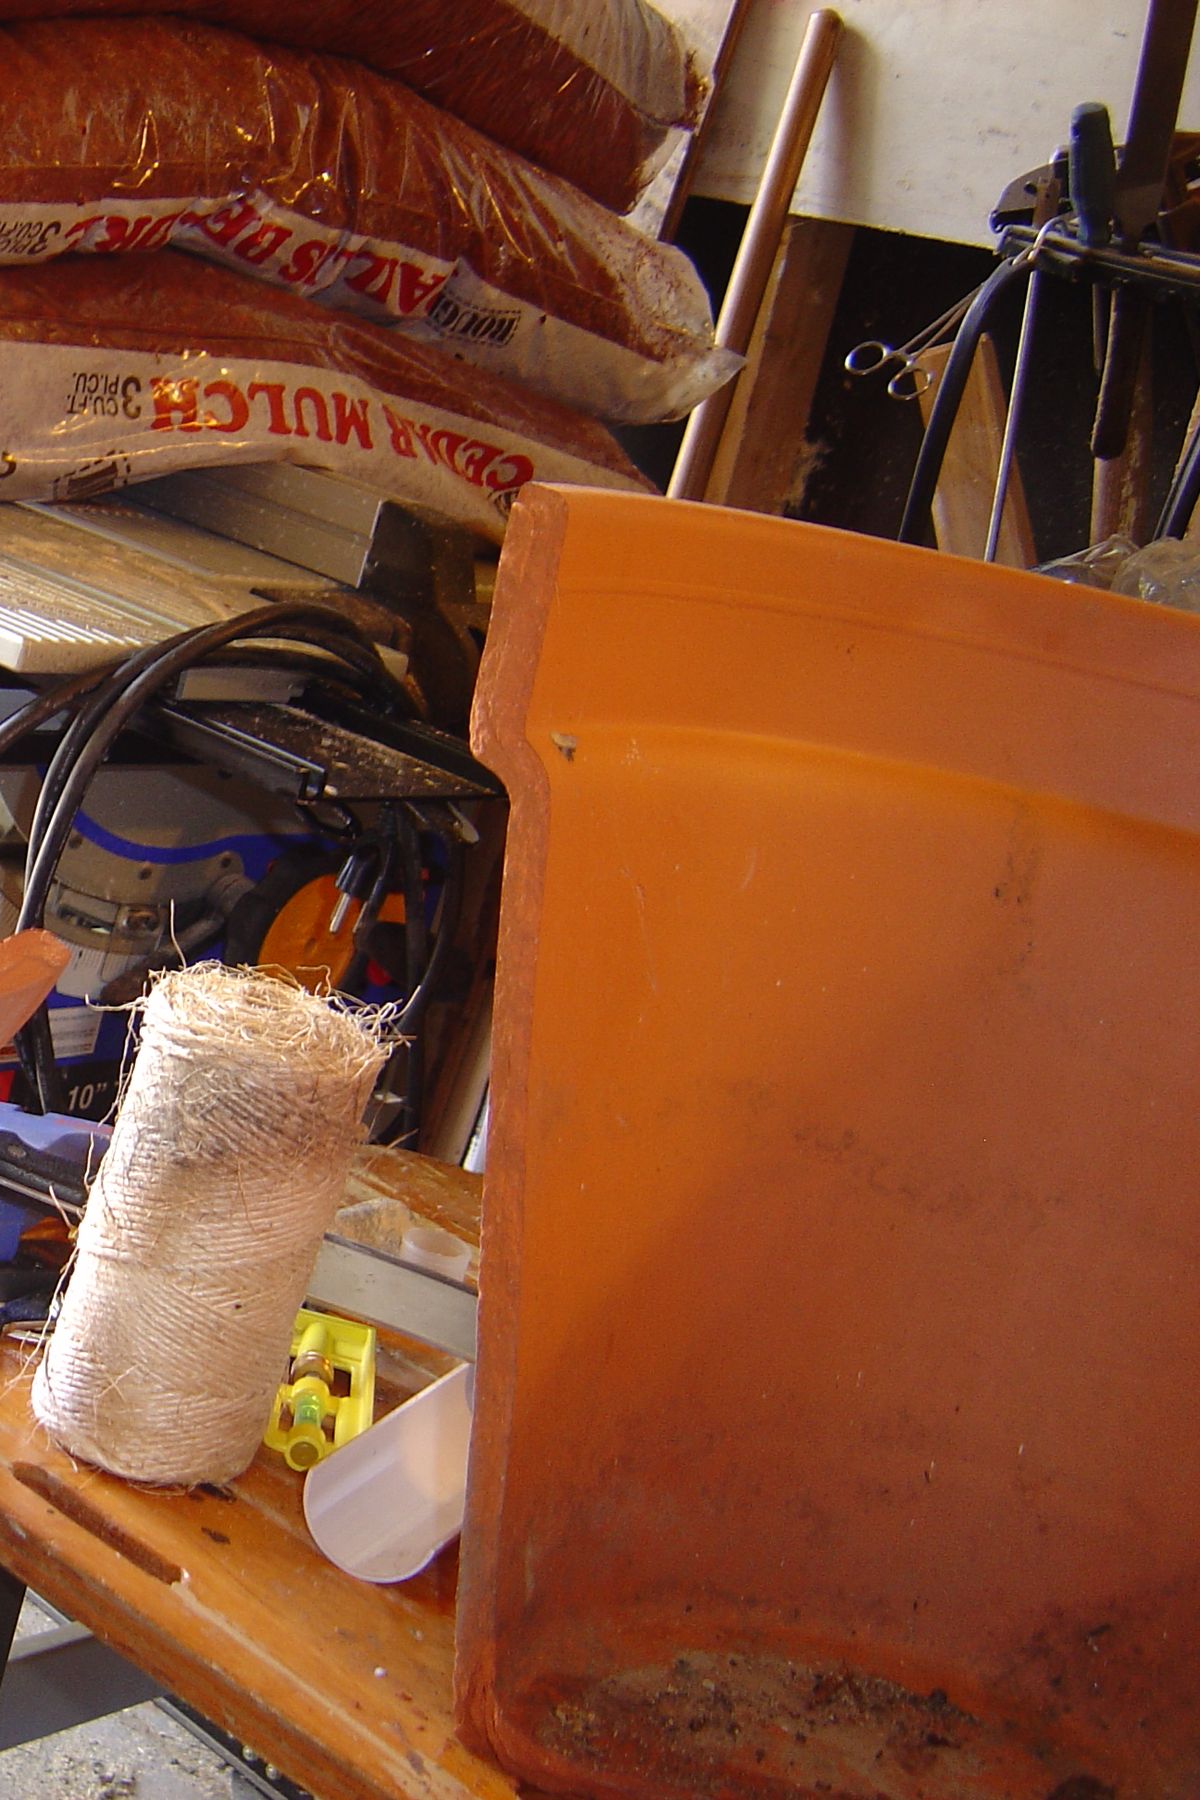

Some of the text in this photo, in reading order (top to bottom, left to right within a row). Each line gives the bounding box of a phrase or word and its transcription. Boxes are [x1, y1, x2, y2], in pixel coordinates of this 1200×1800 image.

[66, 394, 119, 416] CU.FT.
[121, 375, 534, 491] CEDAR MULCH 3
